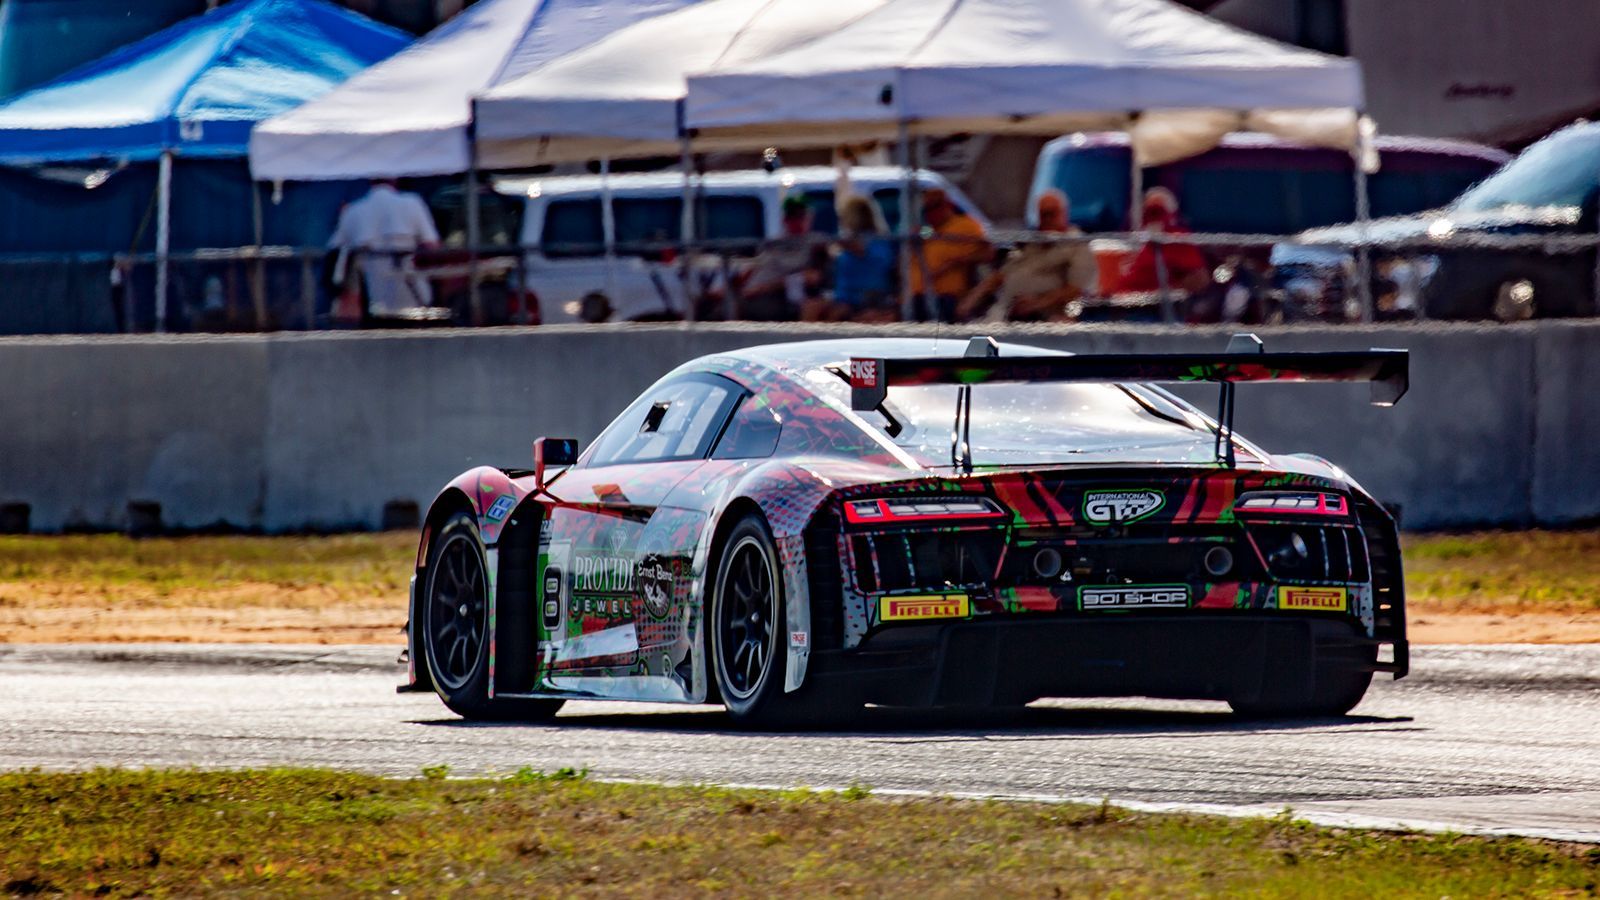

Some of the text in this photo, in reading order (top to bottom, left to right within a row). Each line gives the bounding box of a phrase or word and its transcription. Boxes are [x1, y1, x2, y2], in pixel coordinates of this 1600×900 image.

[1088, 493, 1149, 501] INTERNATIONAL
[1086, 500, 1130, 521] GT
[638, 560, 656, 578] Ernst
[1124, 592, 1187, 604] SHOP
[1287, 590, 1341, 608] PIRELLI
[890, 600, 961, 617] PIRELLI
